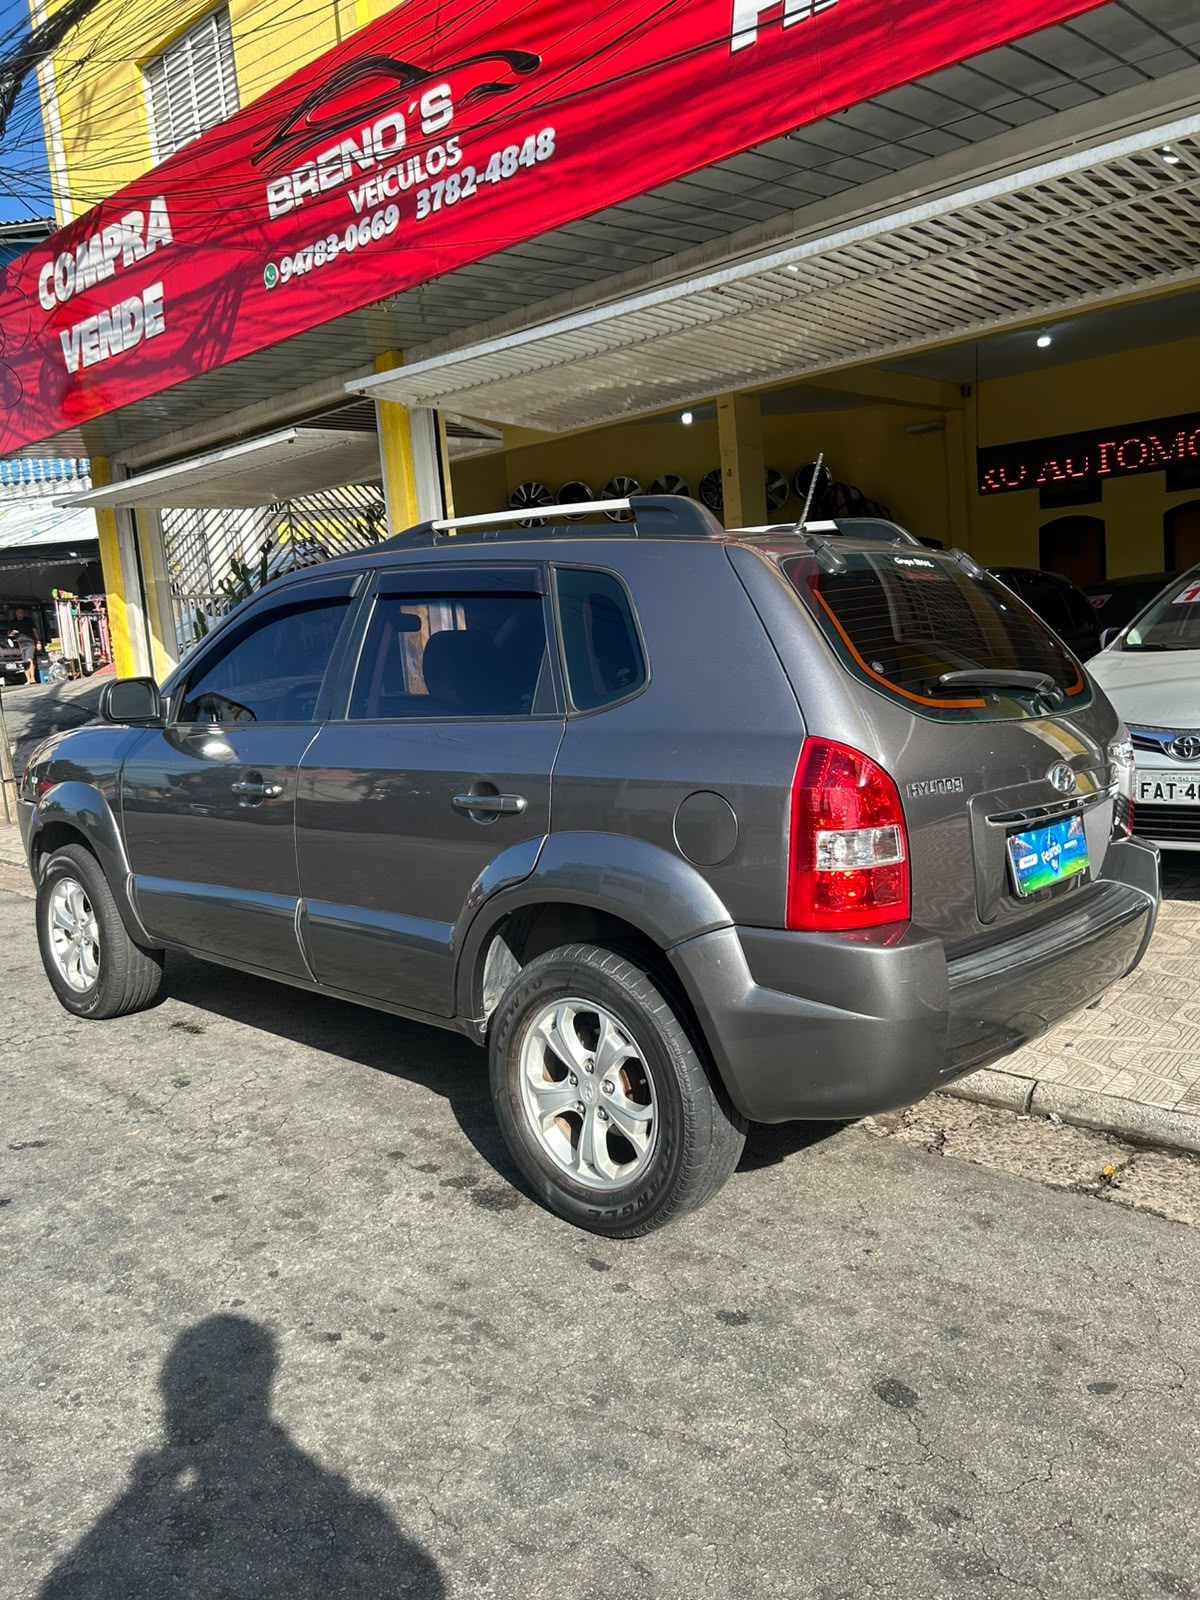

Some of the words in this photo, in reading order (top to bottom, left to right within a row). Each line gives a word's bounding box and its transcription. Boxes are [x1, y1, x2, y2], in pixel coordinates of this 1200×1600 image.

[279, 205, 401, 283] 94783-0669
[416, 127, 556, 221] 3782-4848
[348, 136, 462, 213] VEÍCULOS
[38, 196, 174, 311] COMPRA
[59, 282, 166, 374] VENDE
